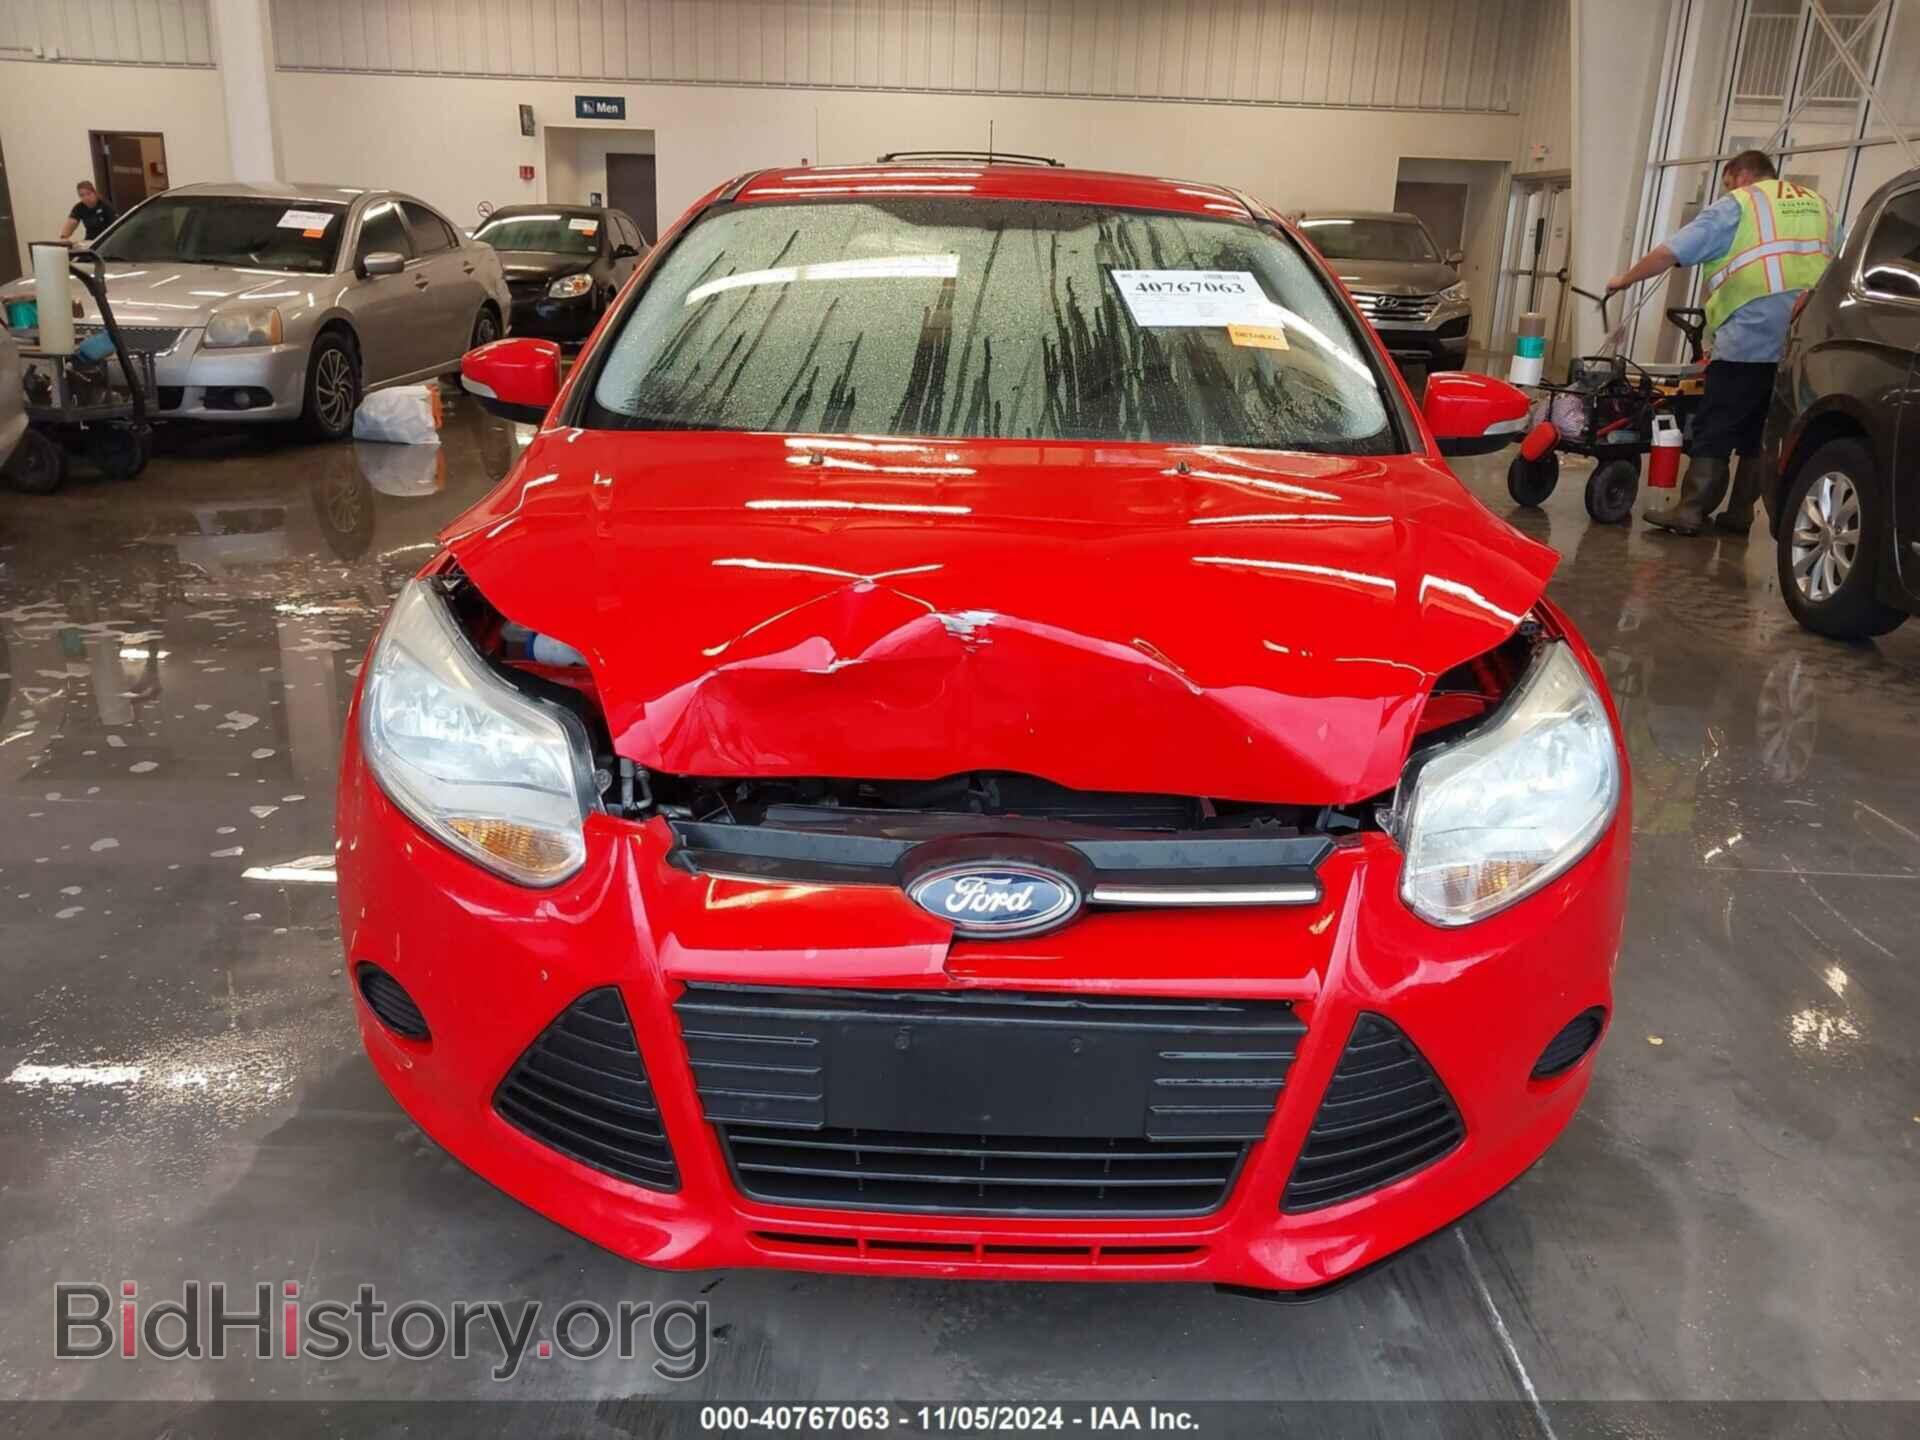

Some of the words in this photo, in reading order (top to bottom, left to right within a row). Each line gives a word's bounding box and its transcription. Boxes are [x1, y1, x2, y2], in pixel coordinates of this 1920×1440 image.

[596, 102, 619, 113] Men
[1135, 282, 1245, 293] 40767063
[945, 876, 1033, 912] Ford
